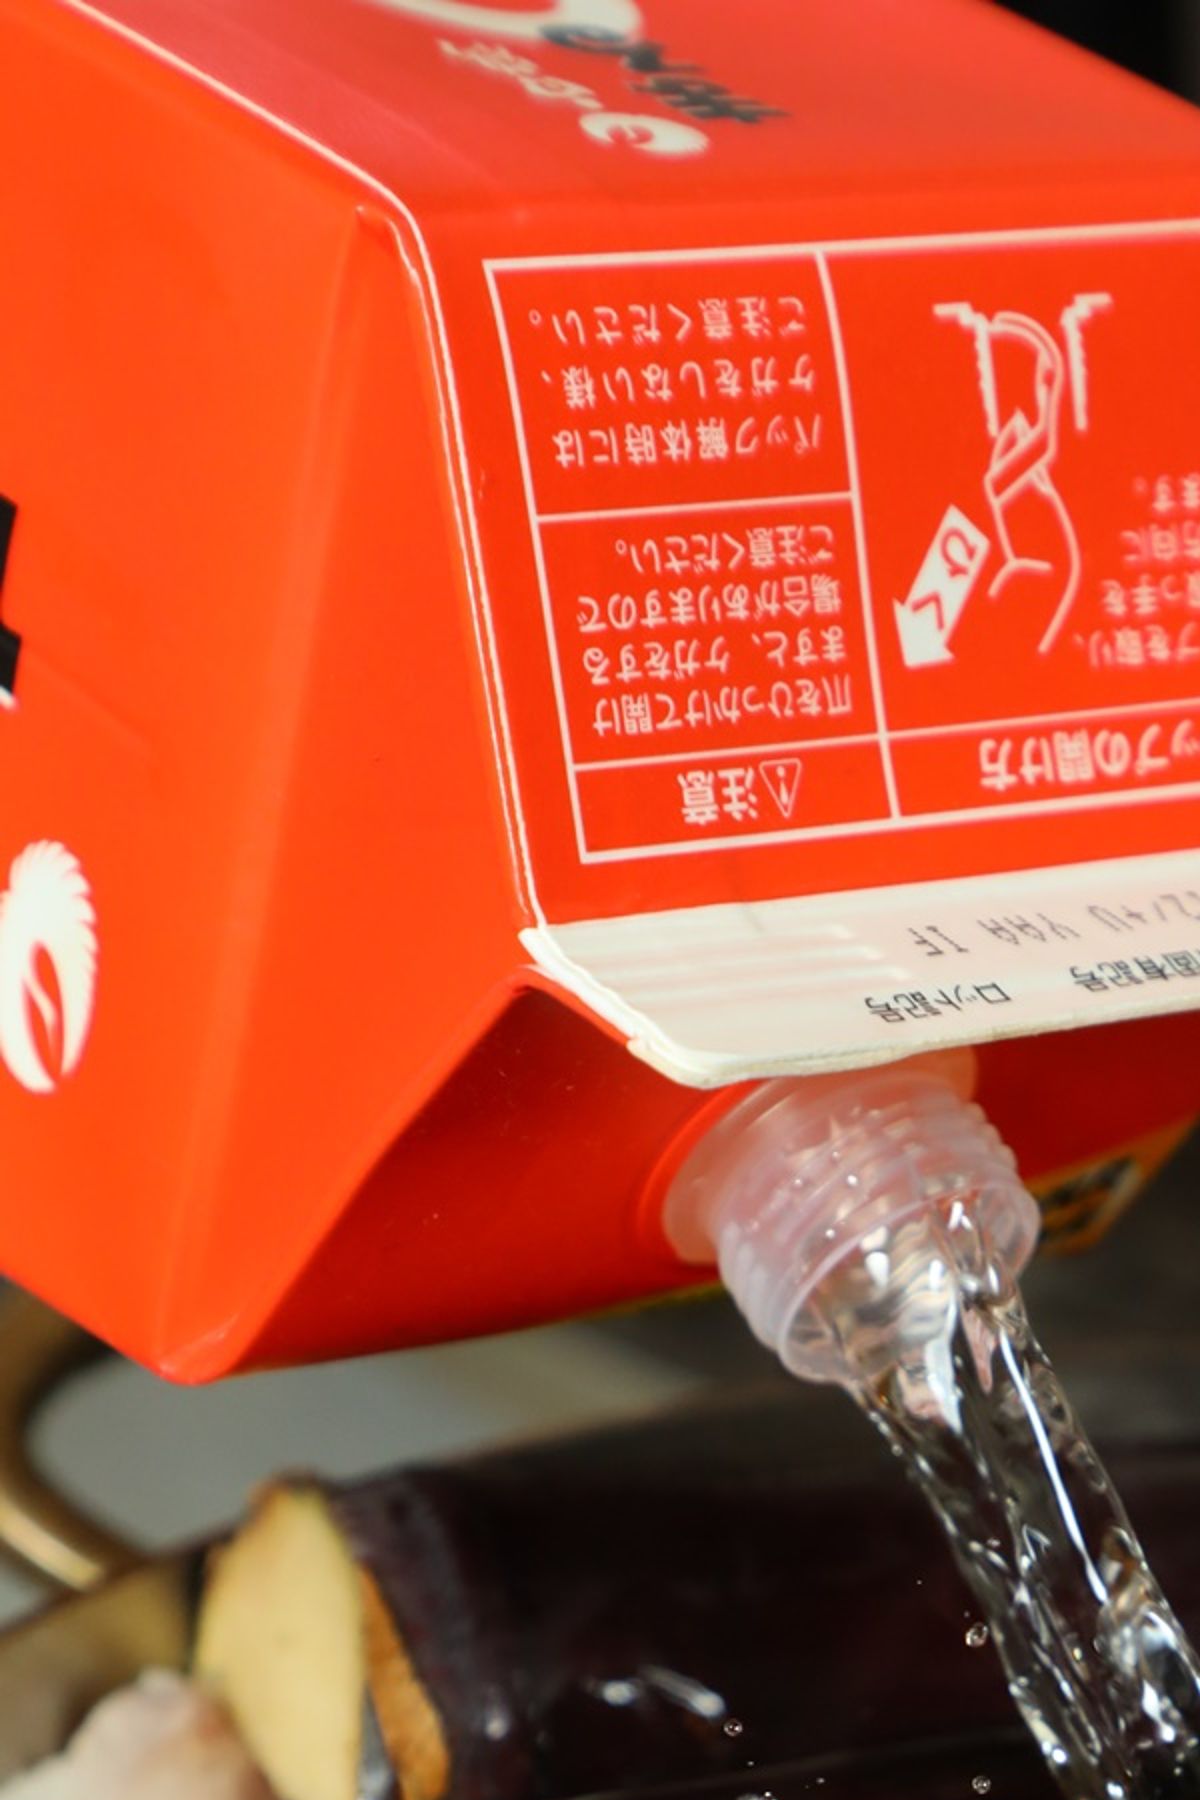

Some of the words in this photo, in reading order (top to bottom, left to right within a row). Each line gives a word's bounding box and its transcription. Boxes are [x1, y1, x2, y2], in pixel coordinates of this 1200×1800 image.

[528, 296, 806, 346] ご注意ください。
[540, 353, 815, 409] ケガをしない様、
[552, 414, 822, 466] パック解体時には
[615, 524, 834, 574] ご注意ください。
[576, 573, 841, 634] 場合がありますので
[582, 625, 846, 685] ますと、ケガをする
[593, 673, 852, 736] 爪をひっかけて開け
[678, 767, 758, 825] 注意
[864, 981, 1011, 1022] ロット記号
